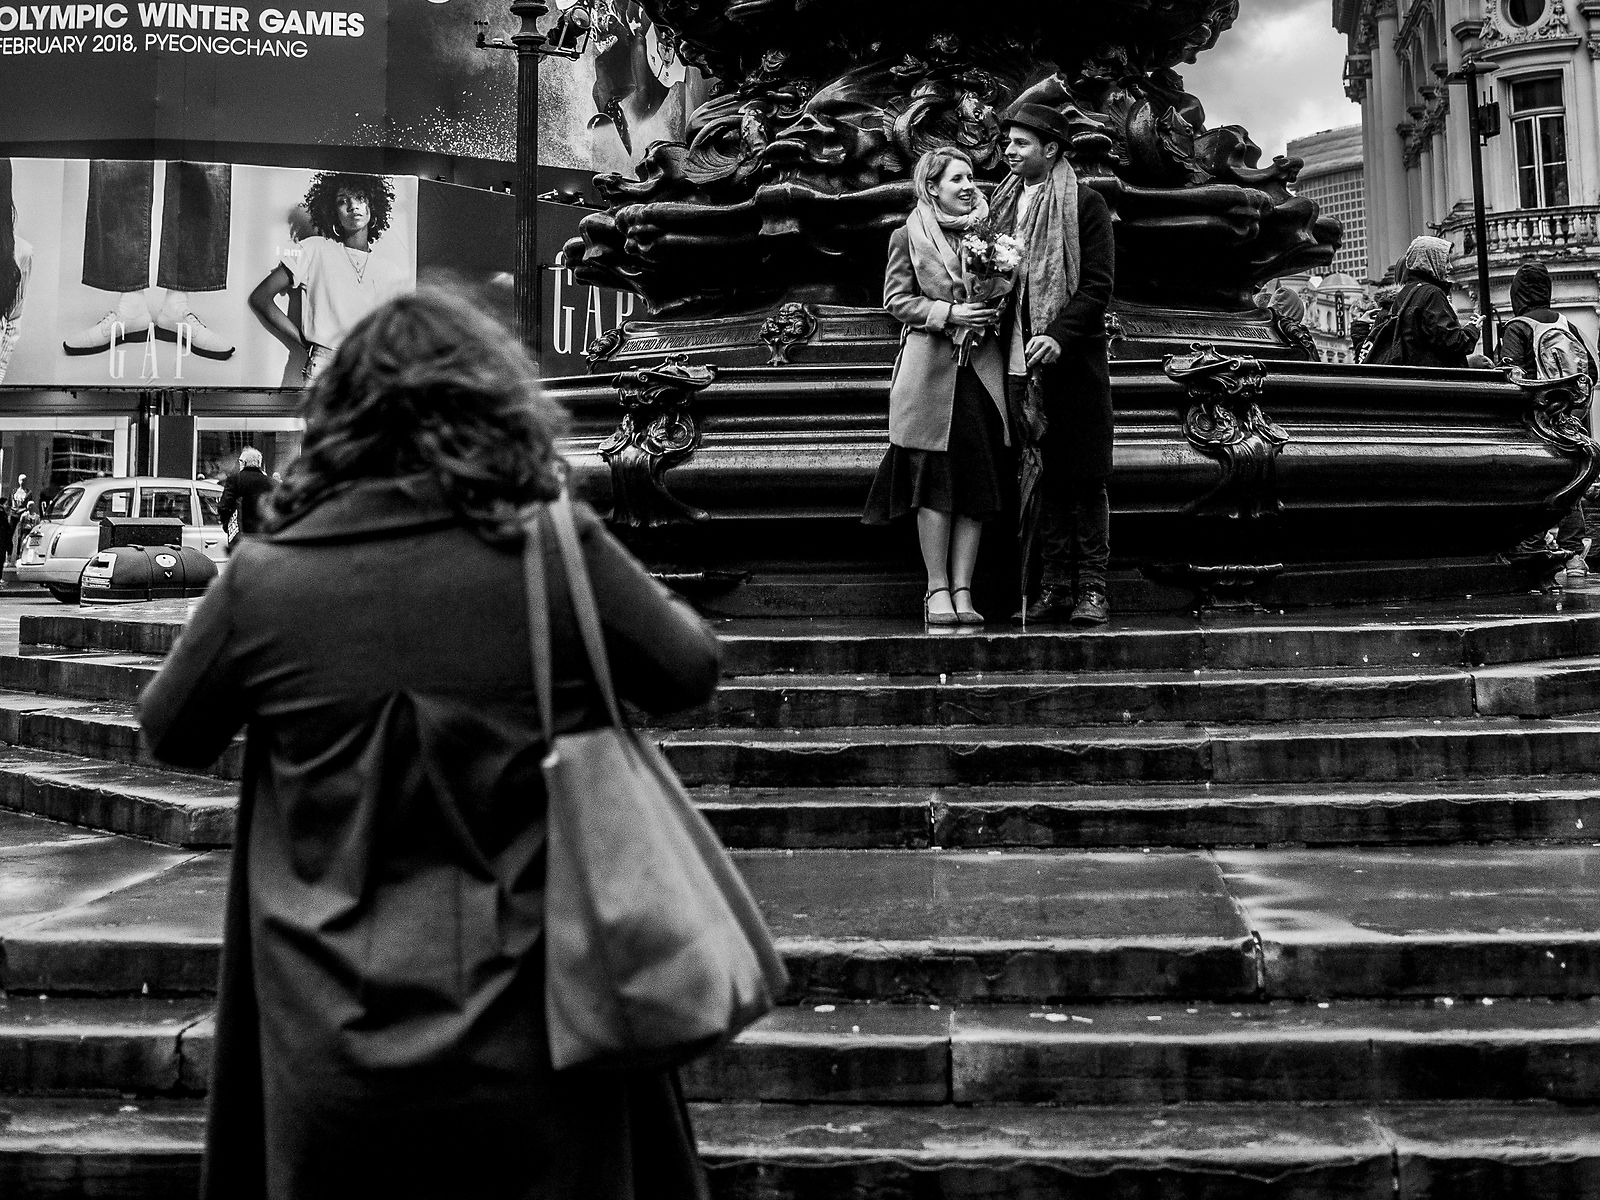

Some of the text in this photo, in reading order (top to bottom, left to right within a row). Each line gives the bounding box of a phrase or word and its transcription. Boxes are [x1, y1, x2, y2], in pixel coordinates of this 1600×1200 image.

[0, 2, 365, 38] OLYMPIC WINTER GAMES
[92, 34, 138, 53] 2018,
[145, 34, 308, 58] PYEONGCHANG
[1336, 297, 1345, 337] APOLLO
[109, 321, 192, 379] GAP
